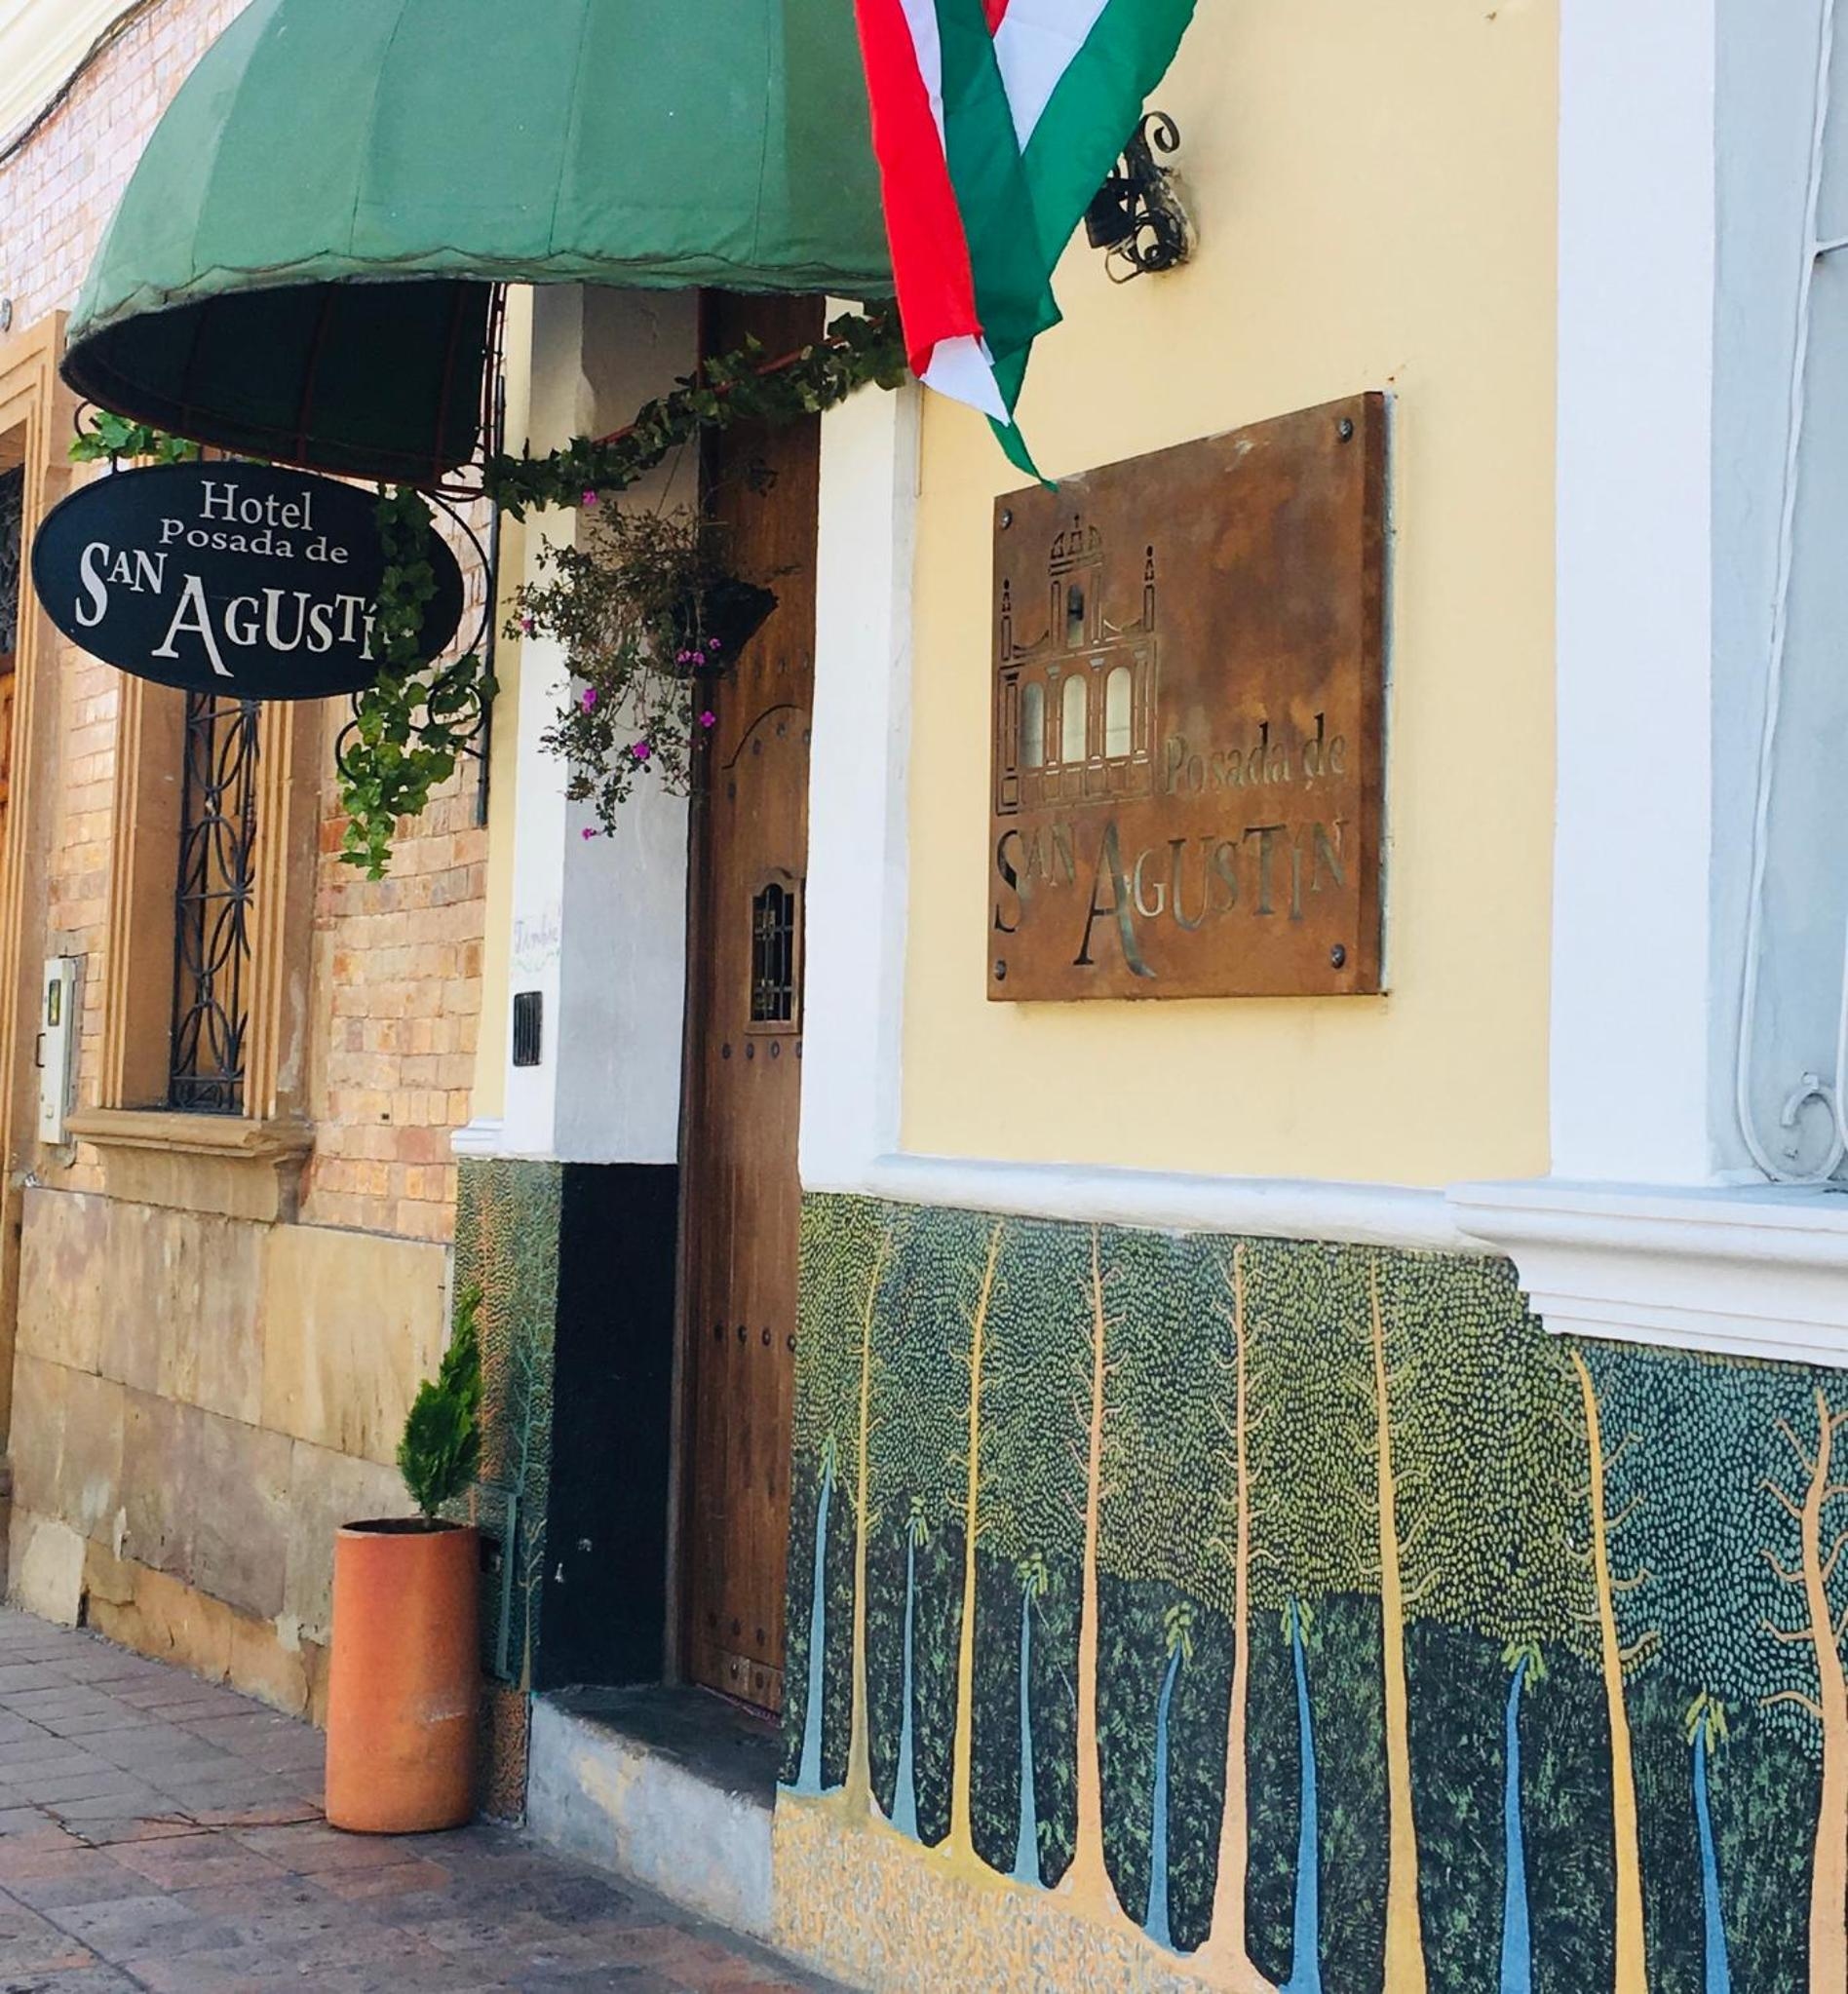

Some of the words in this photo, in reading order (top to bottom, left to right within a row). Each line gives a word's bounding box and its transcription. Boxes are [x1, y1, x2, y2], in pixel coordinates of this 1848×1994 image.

[159, 518, 294, 558] Posada
[305, 535, 350, 564] de
[200, 479, 313, 531] Hotel
[74, 541, 169, 629] SAN
[150, 573, 413, 679] AGUSTÍ
[1163, 721, 1291, 795] Posada
[1302, 712, 1346, 777] de
[993, 822, 1078, 934] SAN
